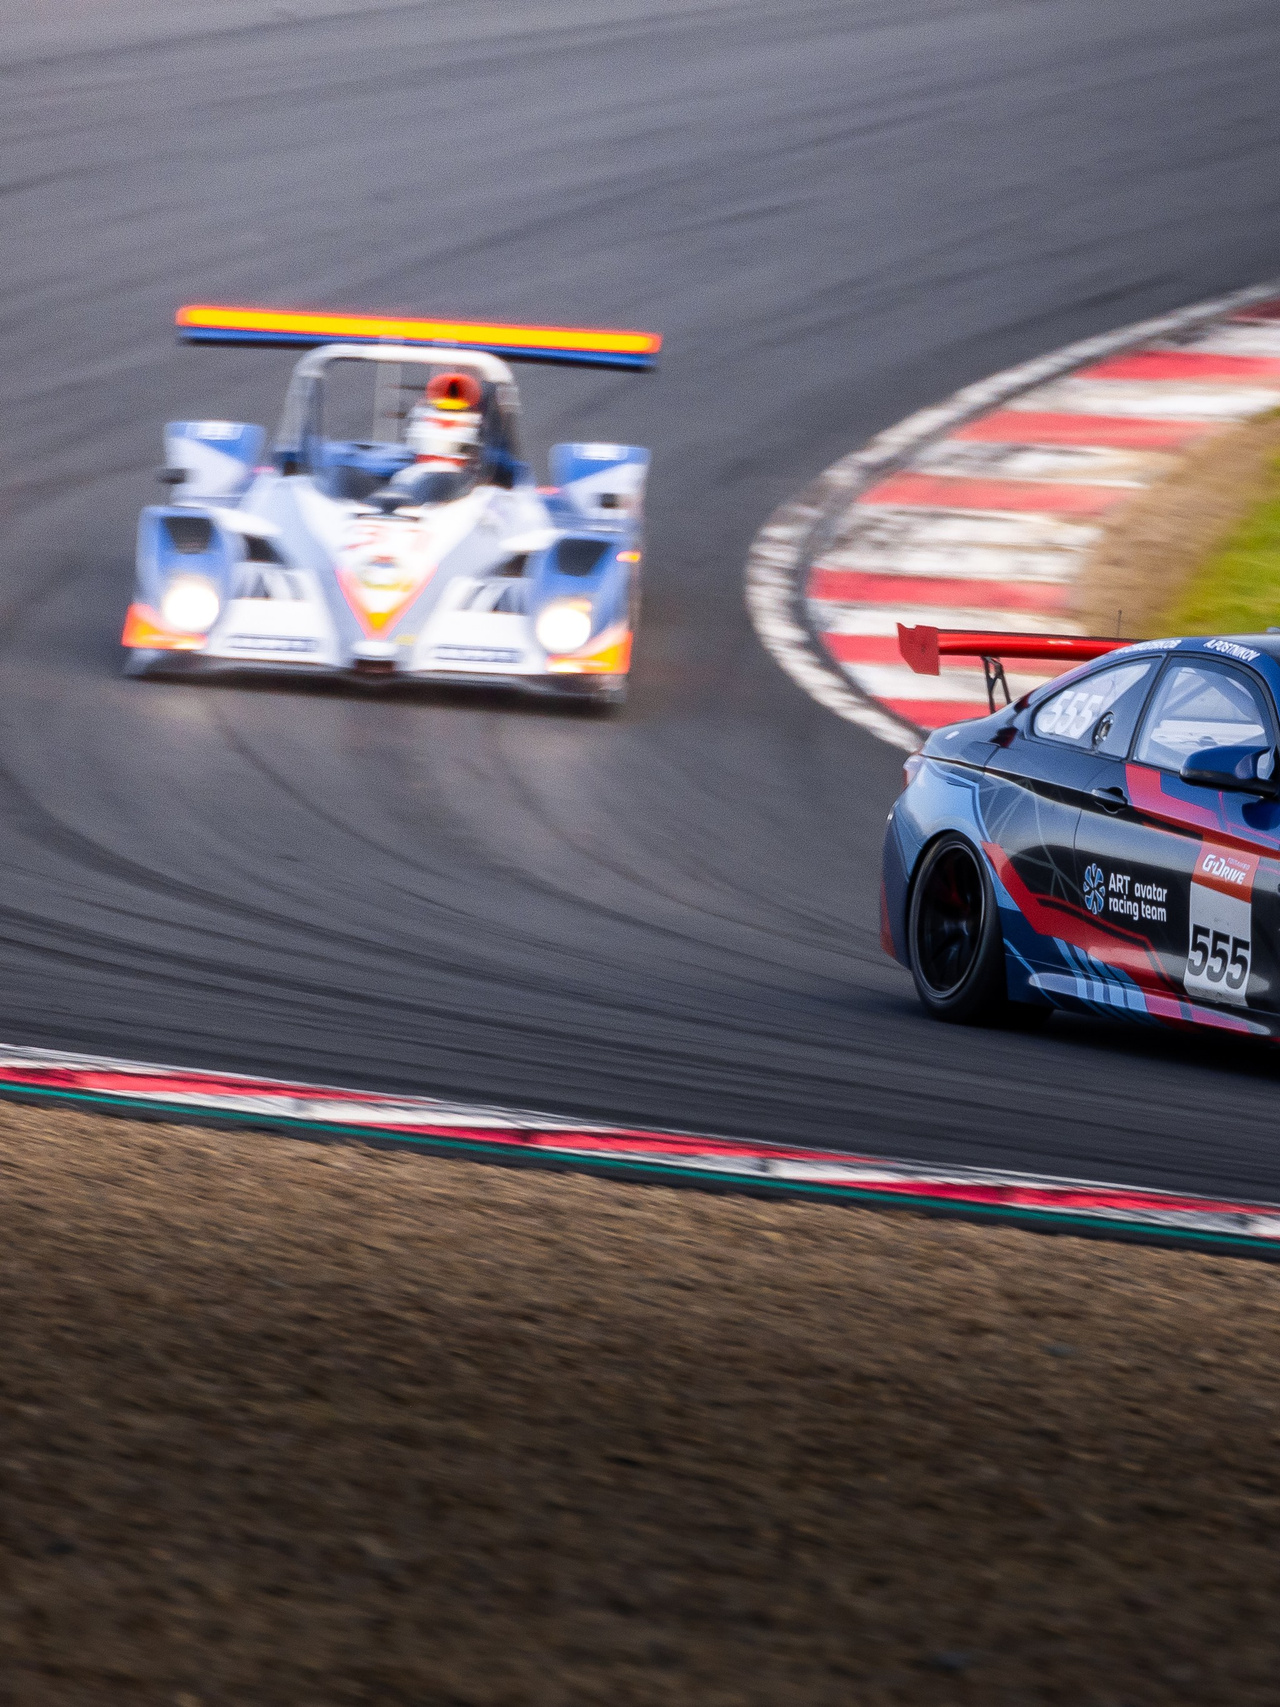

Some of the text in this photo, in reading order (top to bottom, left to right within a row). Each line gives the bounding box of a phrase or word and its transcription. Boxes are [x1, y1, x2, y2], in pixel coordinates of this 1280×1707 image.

[1037, 690, 1104, 740] 555
[1108, 872, 1168, 902] ART avatar
[1108, 895, 1167, 922] racing team
[1187, 924, 1250, 990] 555
